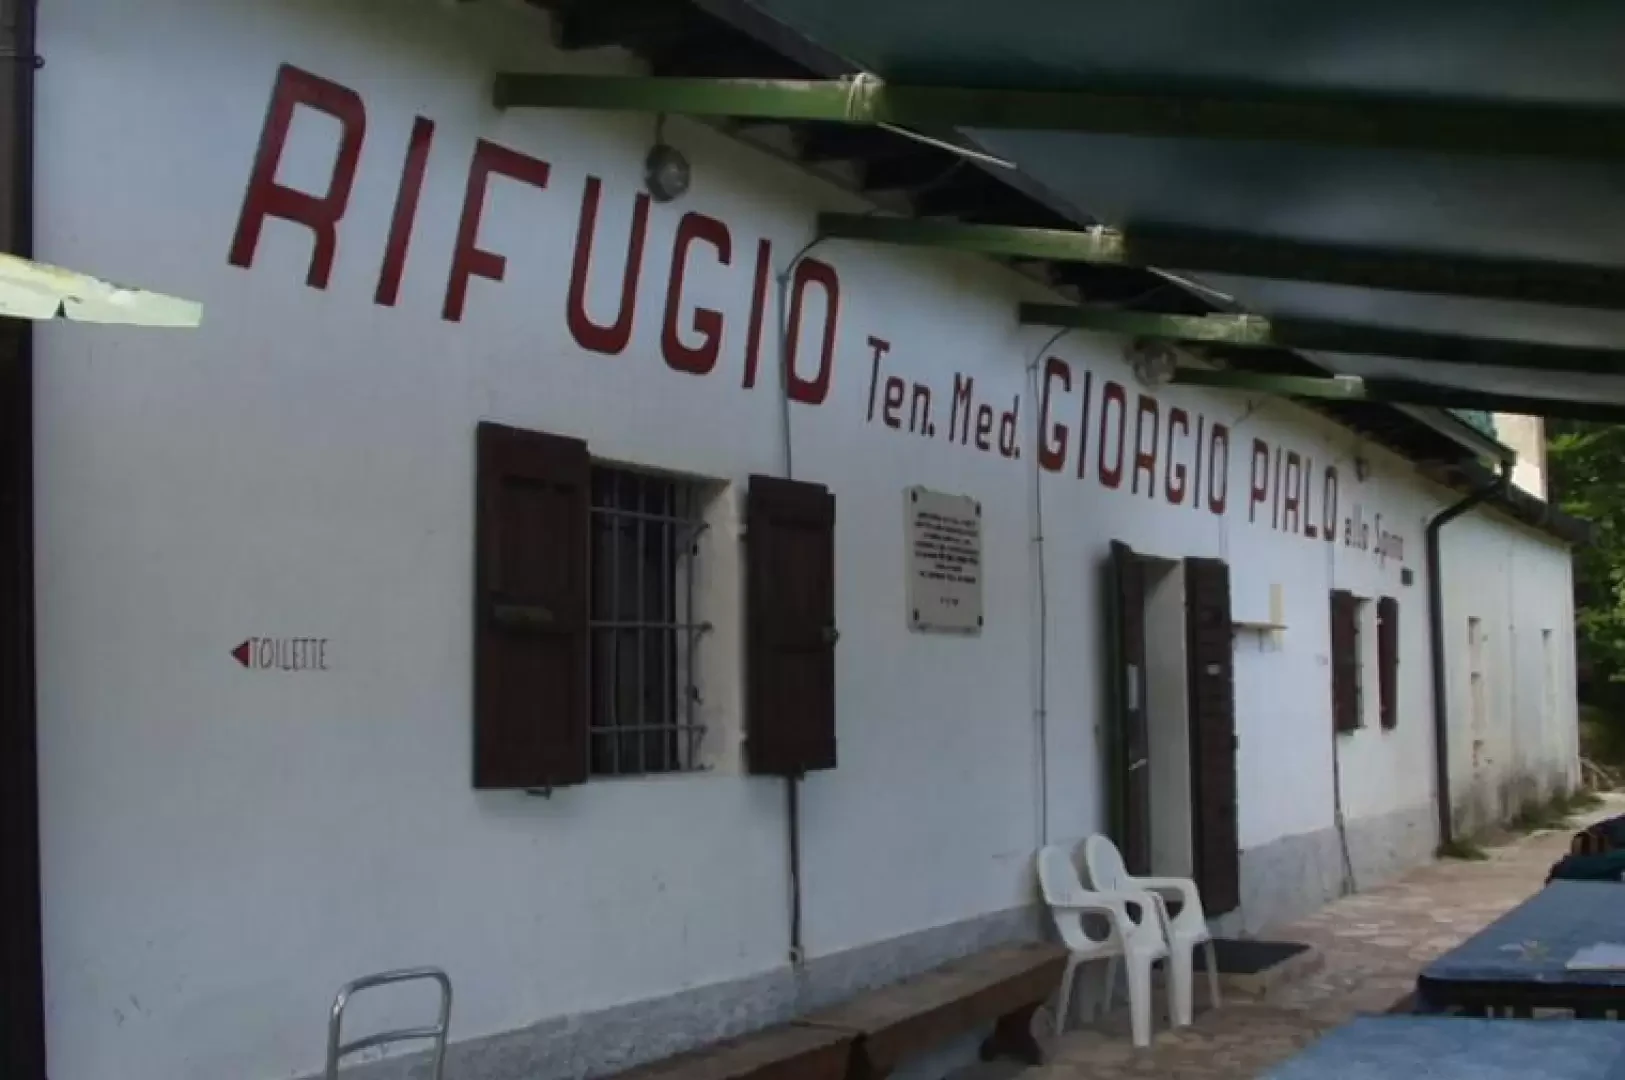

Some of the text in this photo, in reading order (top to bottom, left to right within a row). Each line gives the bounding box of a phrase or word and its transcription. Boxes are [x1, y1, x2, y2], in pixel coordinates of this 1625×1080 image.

[228, 63, 839, 405] RIFUGIO
[866, 335, 934, 437] Ten.
[949, 371, 1020, 459] Med.
[1038, 356, 1229, 515] GIORGIO
[250, 636, 328, 671] TOILETTE
